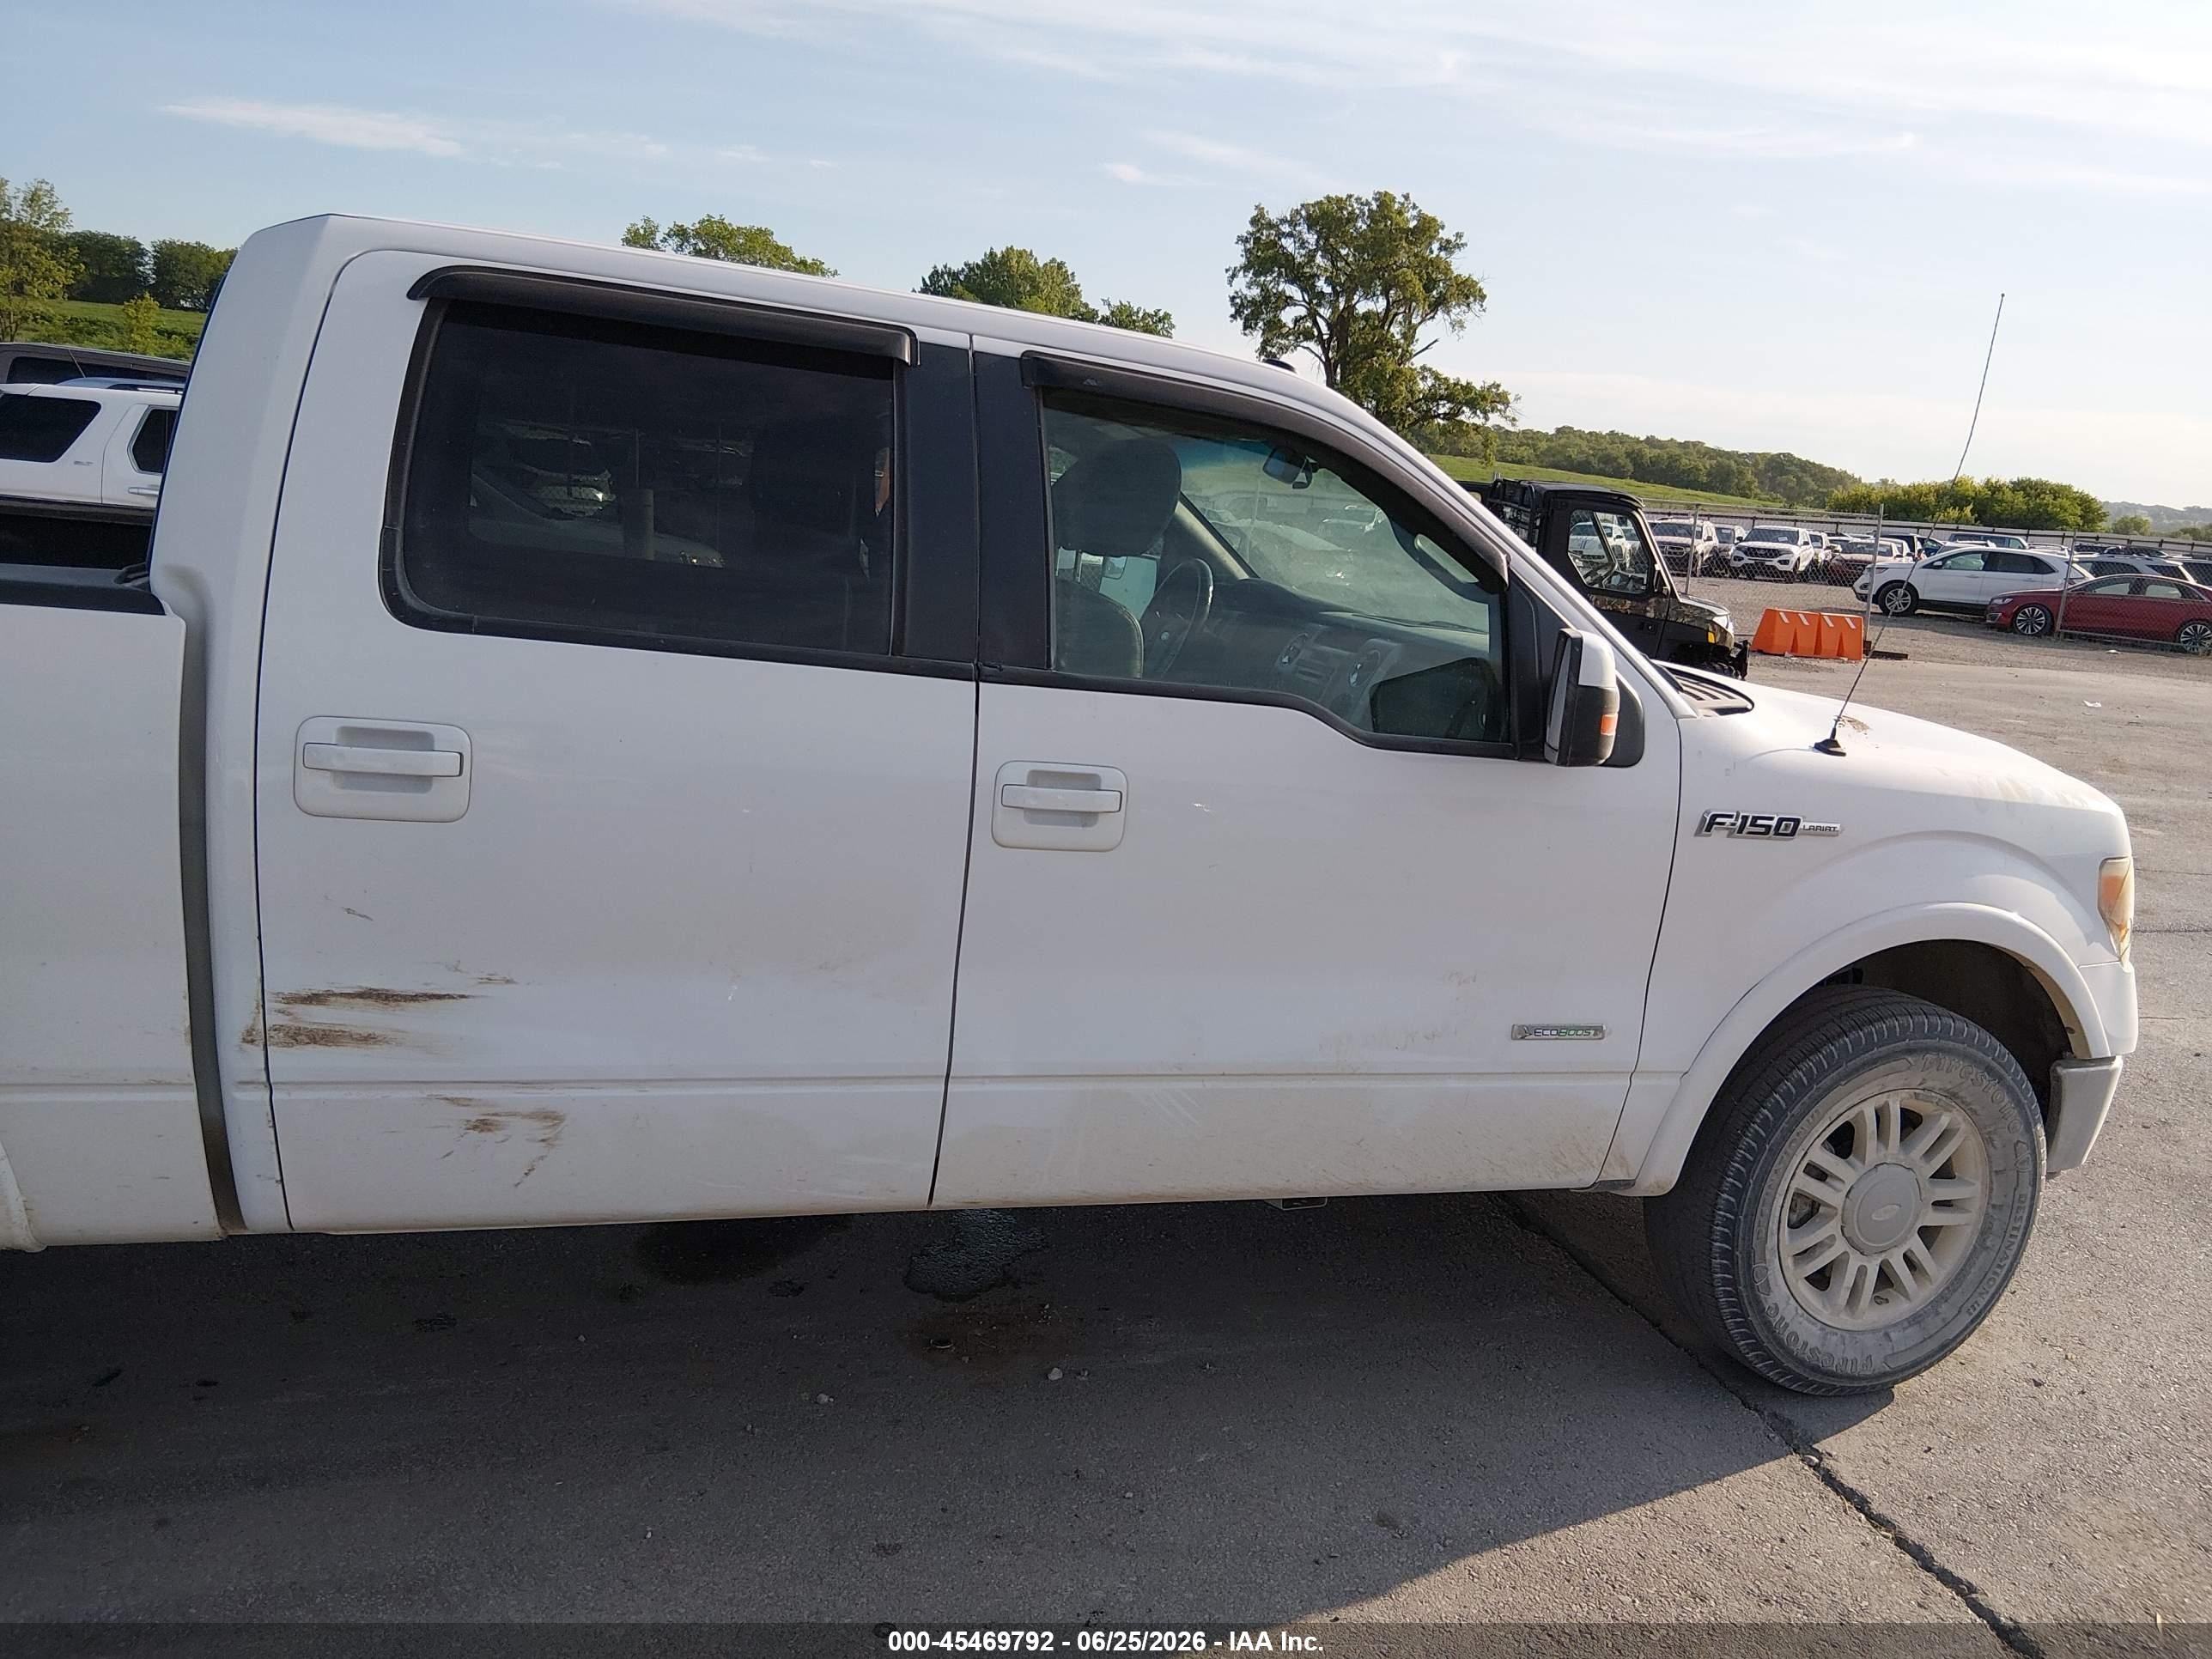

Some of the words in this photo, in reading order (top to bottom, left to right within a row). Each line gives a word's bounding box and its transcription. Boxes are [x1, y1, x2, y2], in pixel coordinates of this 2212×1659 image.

[1703, 811, 1802, 838] F-150
[1803, 823, 1838, 833] LARIAT
[1922, 1052, 2022, 1134] Firestone
[1982, 1193, 2027, 1300] DESTINATION
